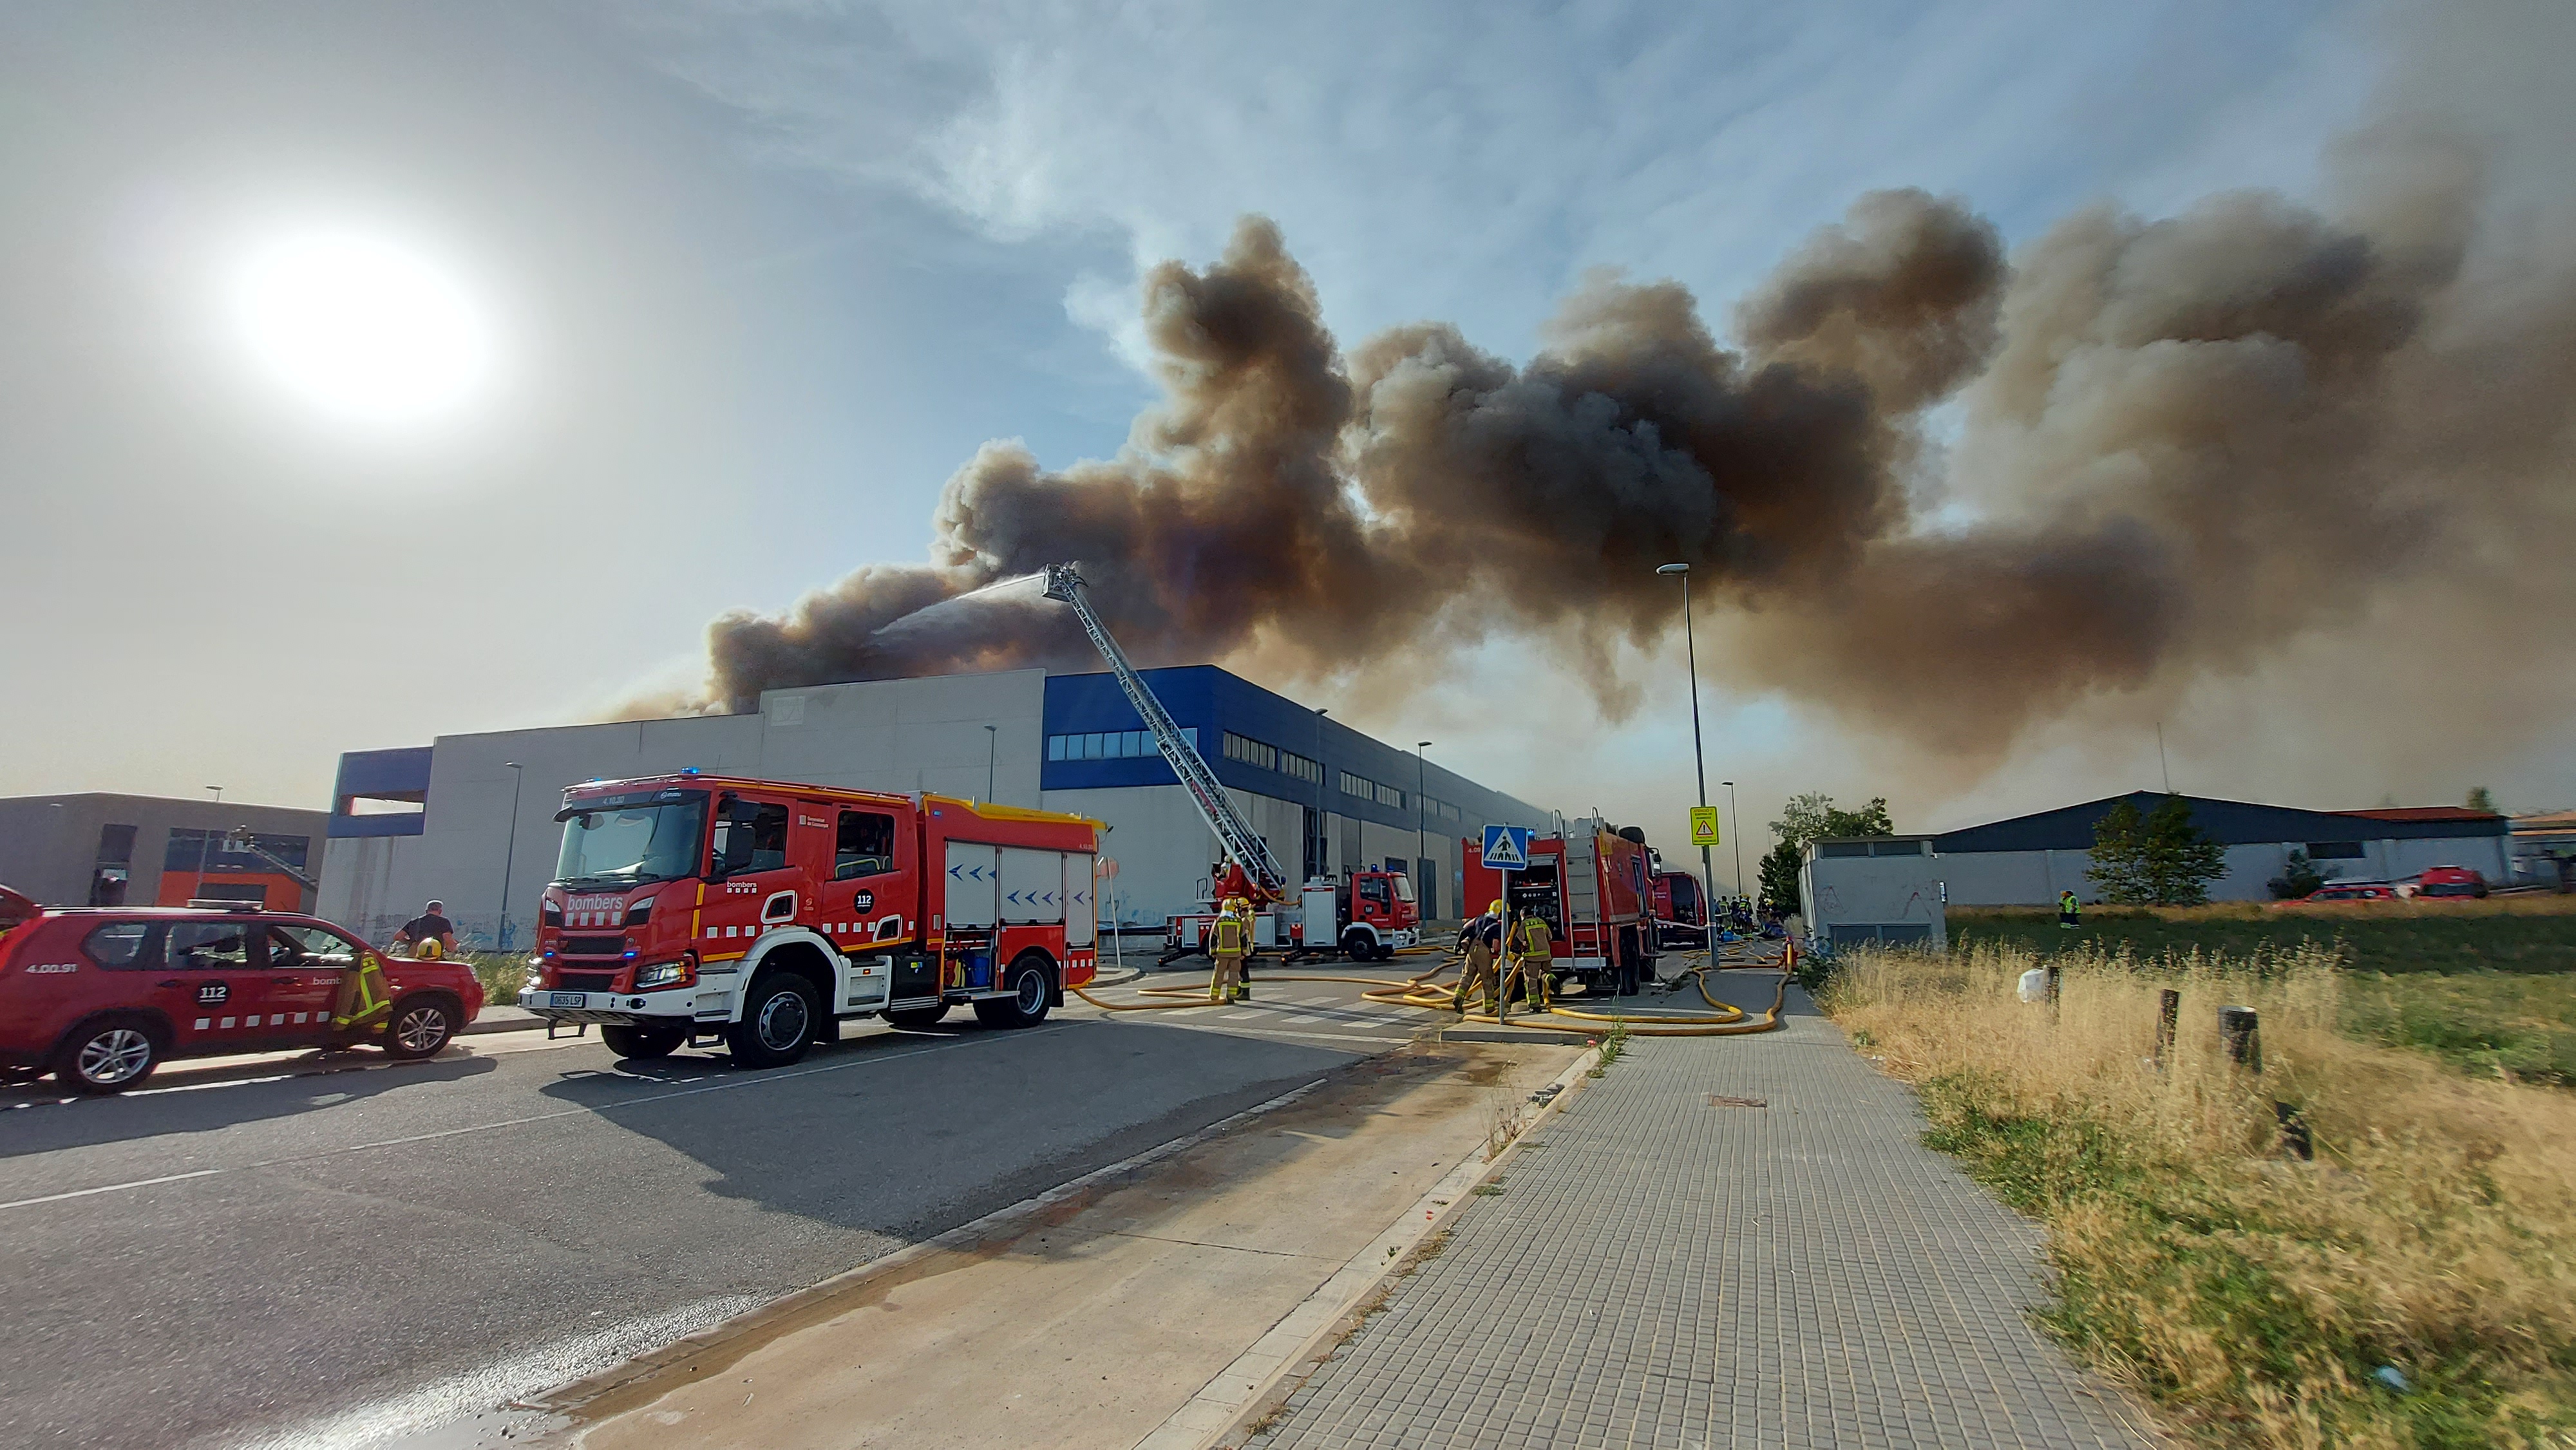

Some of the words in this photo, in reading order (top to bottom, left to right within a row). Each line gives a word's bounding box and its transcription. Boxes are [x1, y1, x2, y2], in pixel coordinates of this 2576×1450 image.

[567, 894, 623, 911] bombers
[857, 895, 871, 905] 112
[313, 977, 343, 986] bomb
[199, 986, 227, 999] 112
